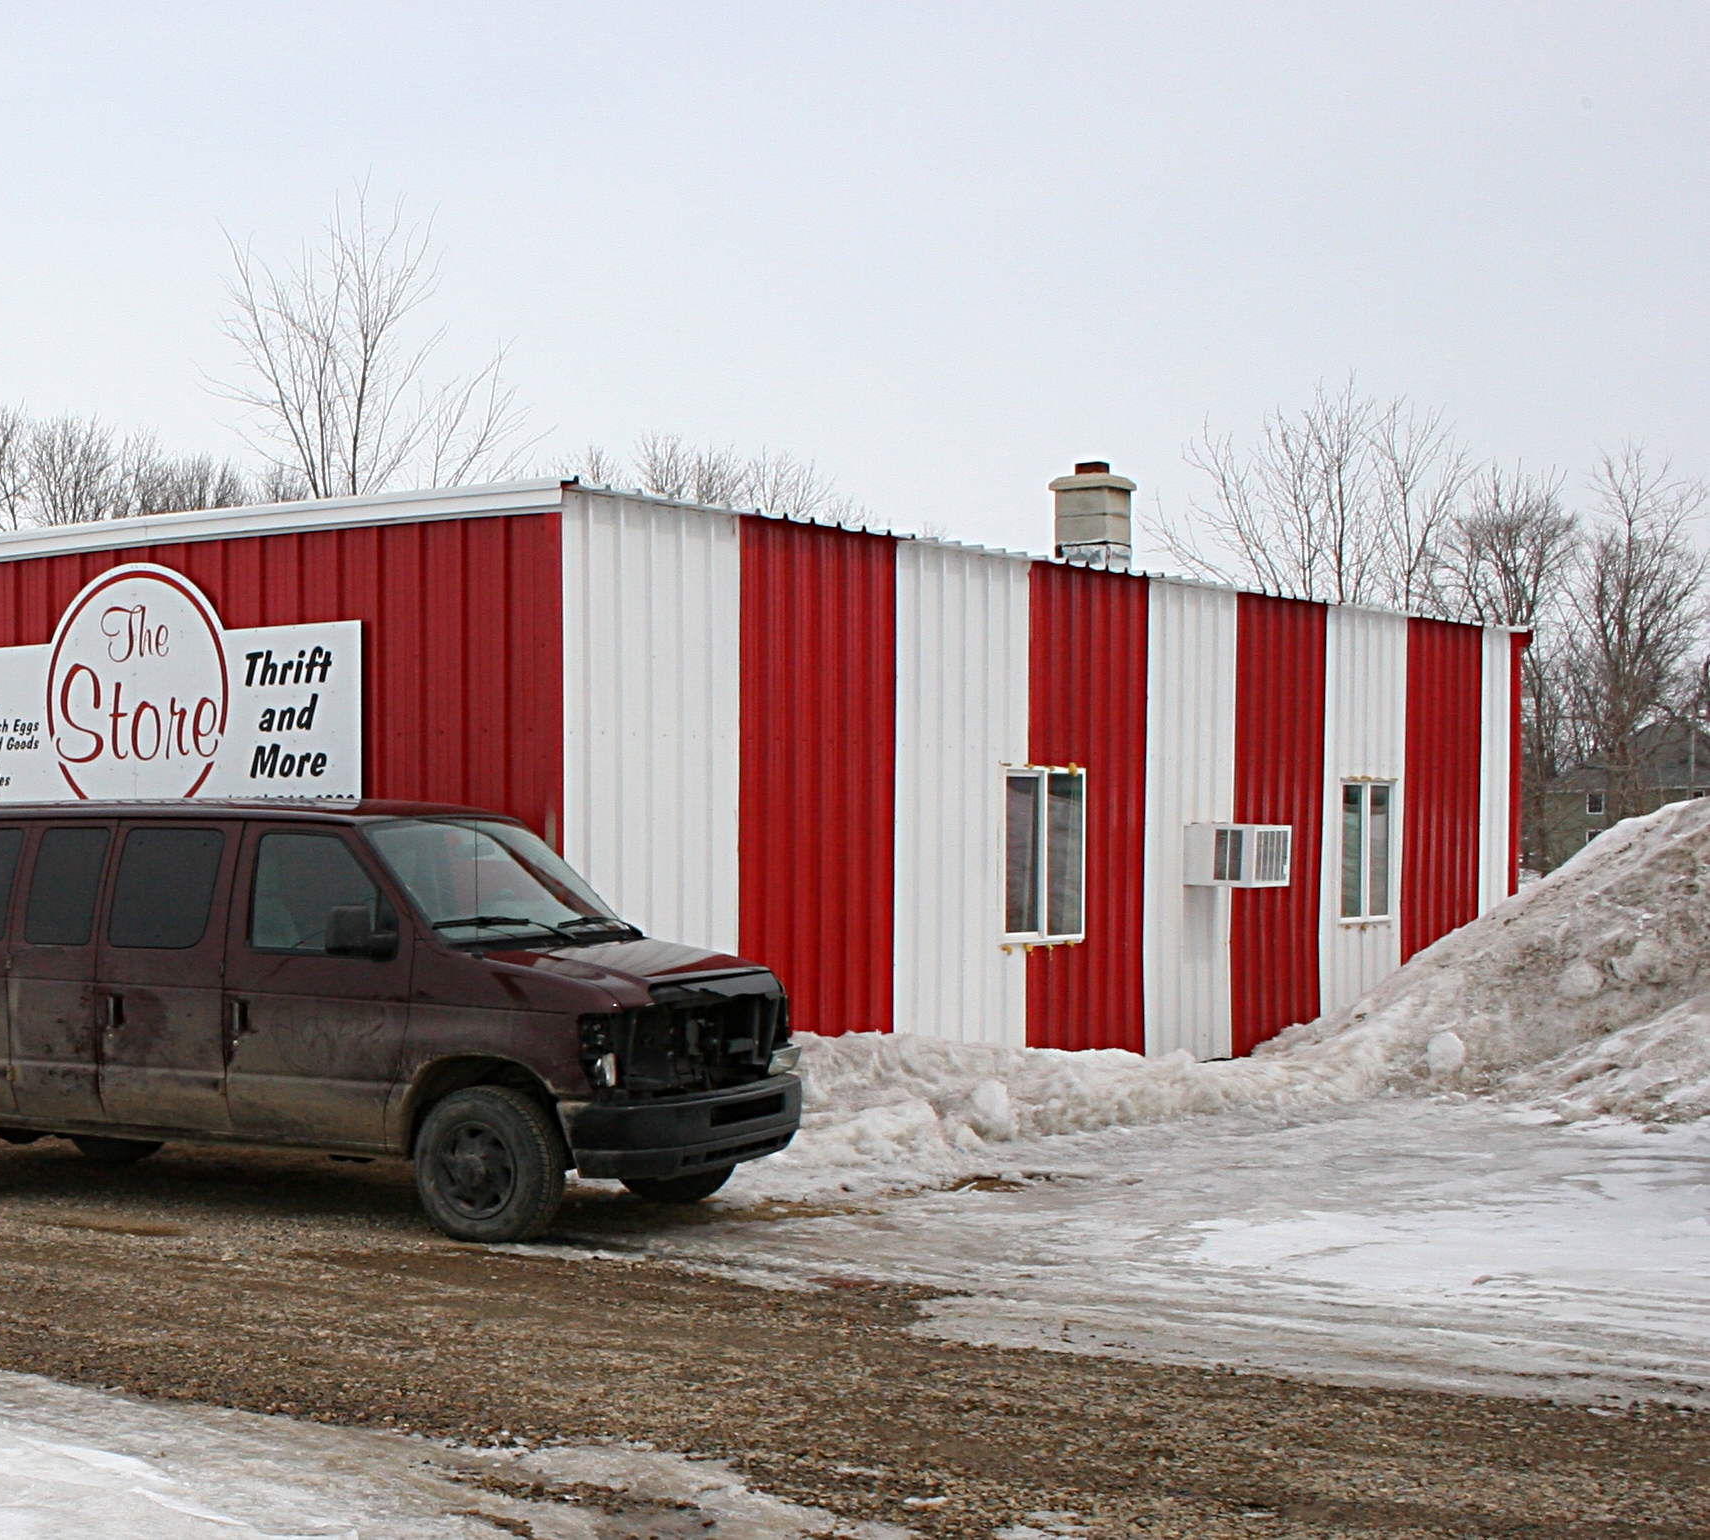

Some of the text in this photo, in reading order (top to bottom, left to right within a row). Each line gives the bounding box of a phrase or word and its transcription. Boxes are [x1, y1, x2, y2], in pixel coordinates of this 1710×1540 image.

[100, 604, 169, 663] The
[244, 646, 332, 688] Thrift
[13, 719, 40, 736] Eggs
[56, 663, 219, 764] Store
[258, 693, 319, 732] and
[6, 735, 40, 751] Goods
[250, 743, 327, 779] More
